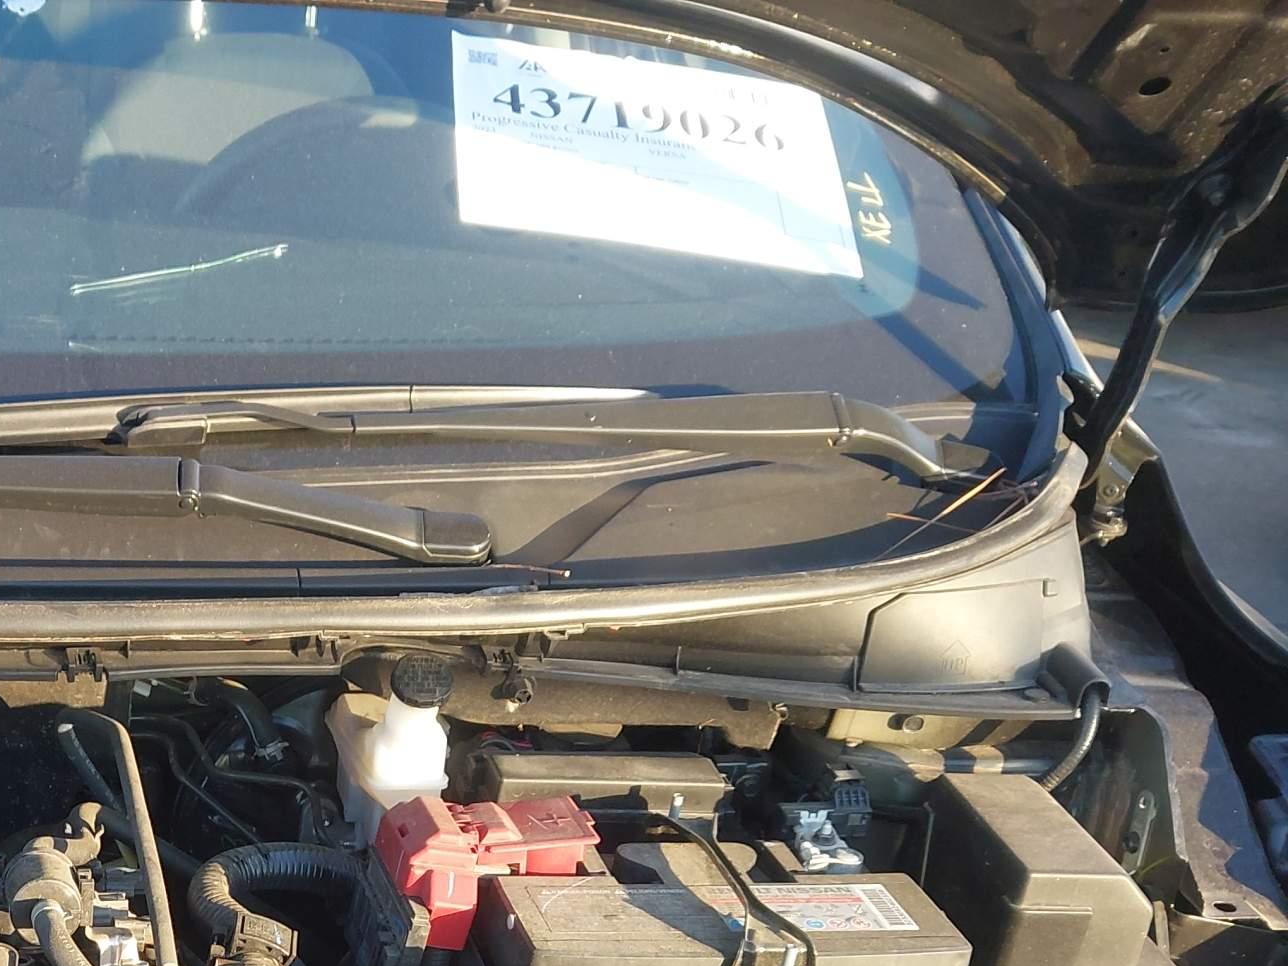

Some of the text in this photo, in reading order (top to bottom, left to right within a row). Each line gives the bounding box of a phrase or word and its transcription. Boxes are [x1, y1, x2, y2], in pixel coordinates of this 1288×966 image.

[472, 111, 559, 132] Progressive
[563, 123, 630, 142] Casualty
[493, 83, 786, 151] 43719026
[778, 886, 851, 894] NISSAN
